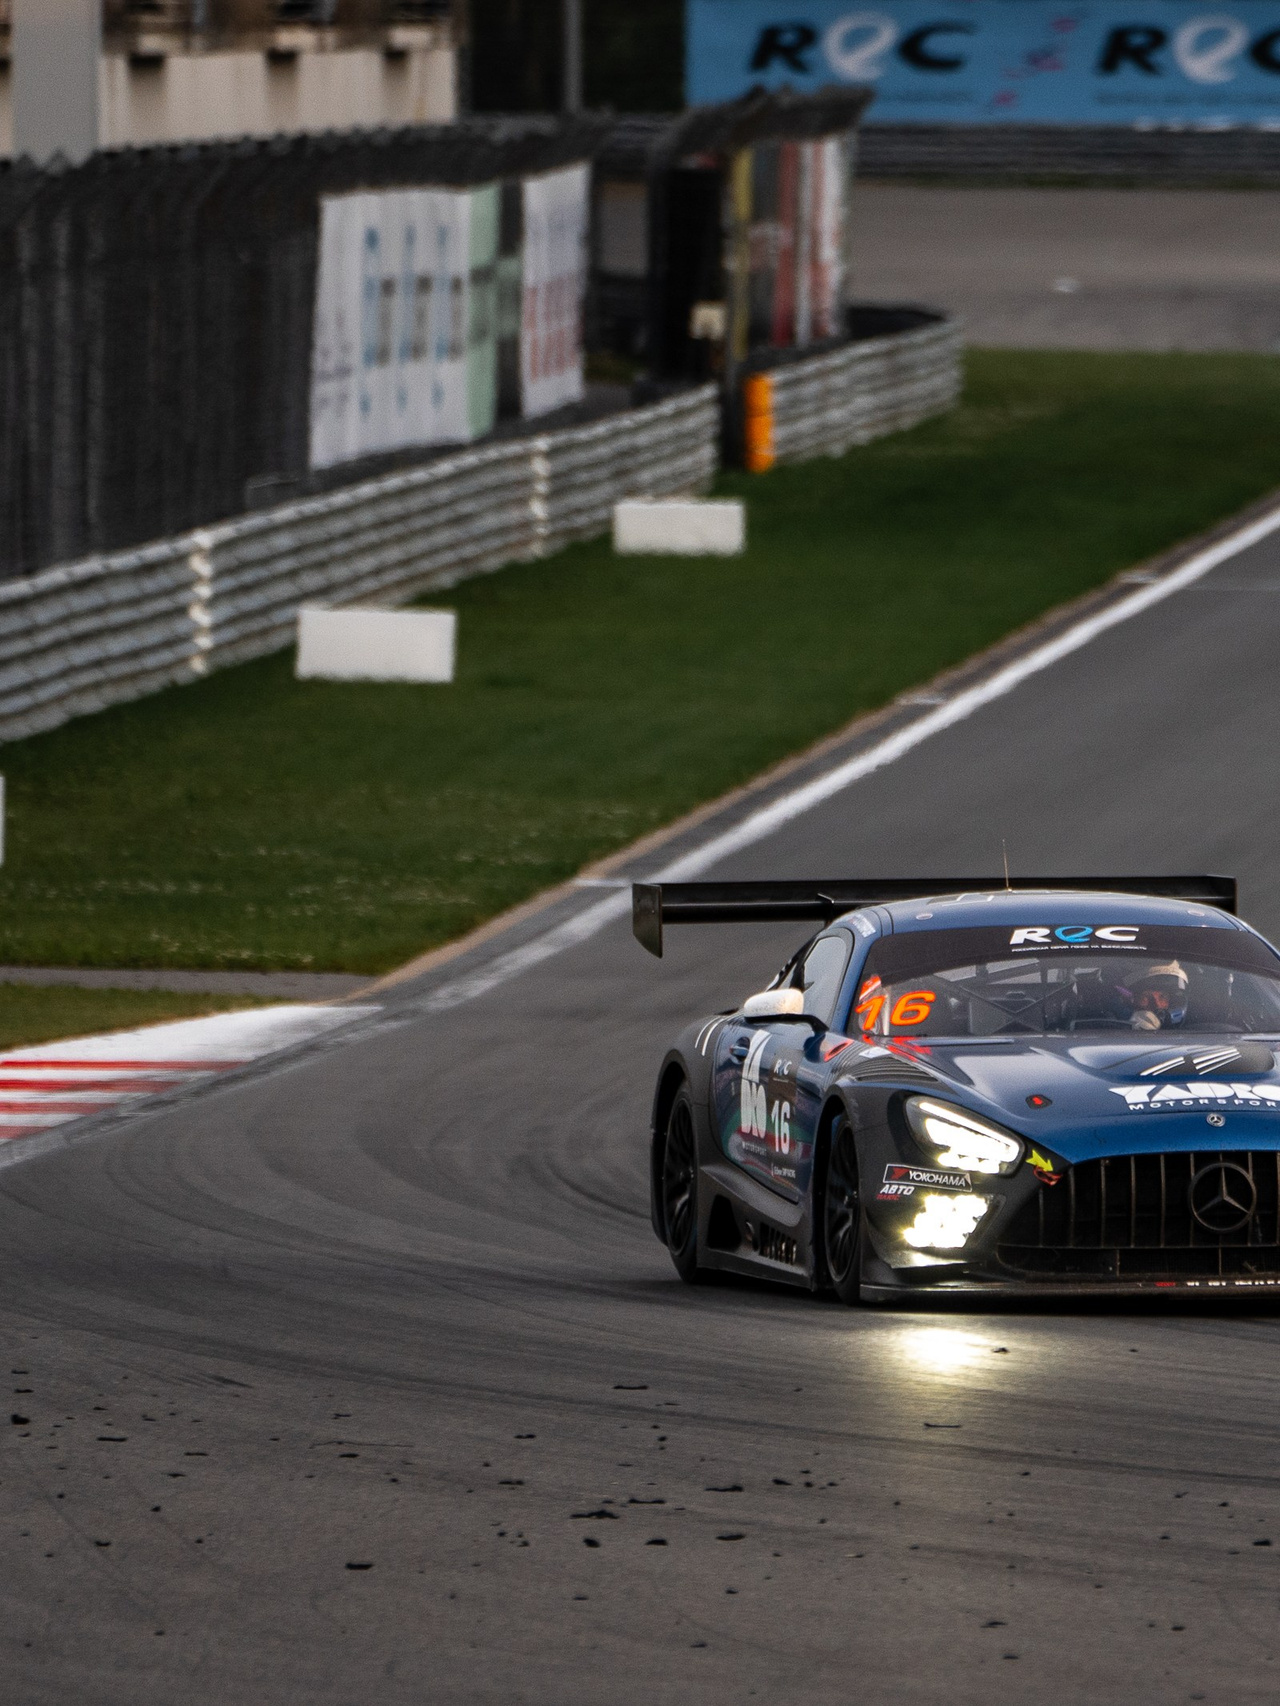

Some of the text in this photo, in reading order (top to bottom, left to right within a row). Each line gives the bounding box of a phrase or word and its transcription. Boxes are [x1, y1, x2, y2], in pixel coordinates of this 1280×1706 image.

[855, 990, 936, 1031] 16
[771, 1100, 791, 1155] 16
[908, 1170, 966, 1187] YOKOHAMA
